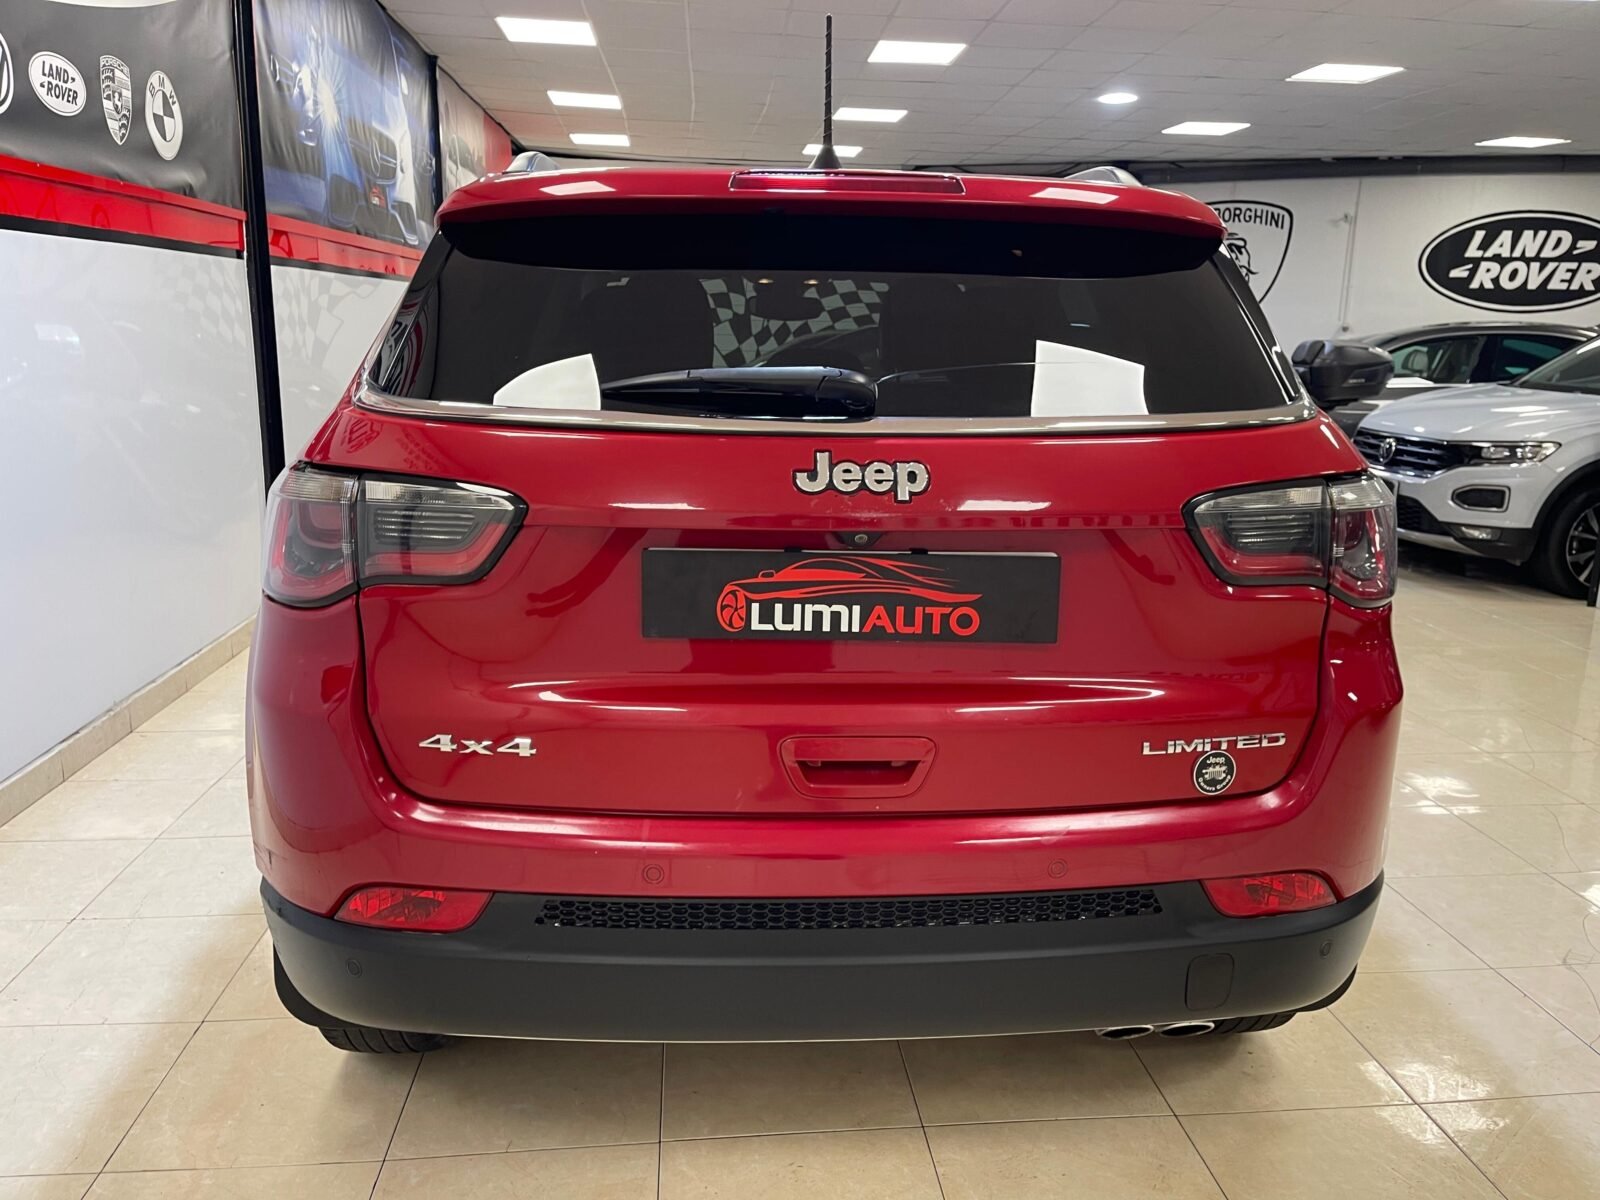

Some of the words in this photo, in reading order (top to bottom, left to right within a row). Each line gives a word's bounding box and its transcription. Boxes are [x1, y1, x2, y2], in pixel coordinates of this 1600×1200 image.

[41, 60, 70, 84] LAND
[46, 83, 78, 106] ROVER
[1464, 229, 1573, 259] LAND
[1469, 261, 1600, 291] ROVER
[793, 450, 931, 503] Jeep
[418, 734, 537, 757] 4x4
[1142, 732, 1286, 755] LIMITED
[1206, 756, 1226, 764] Jeep
